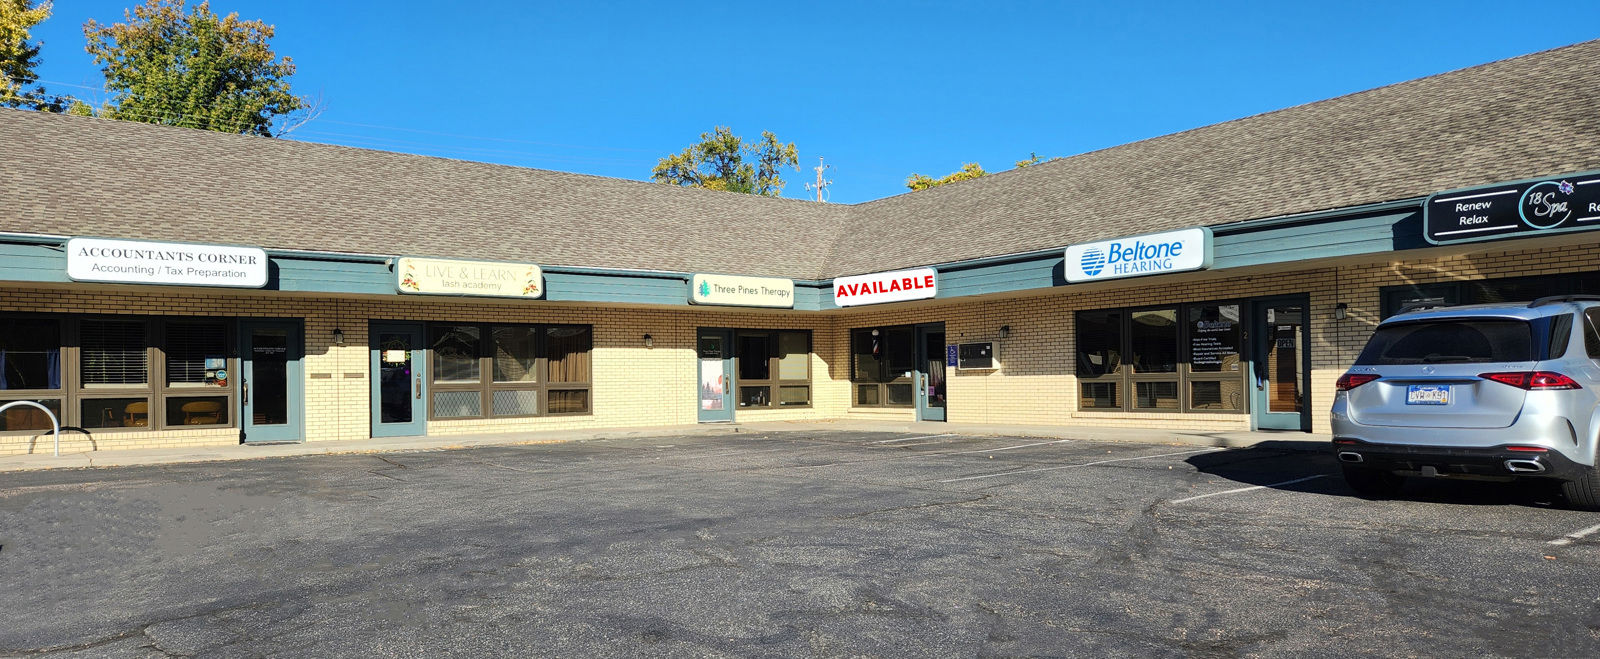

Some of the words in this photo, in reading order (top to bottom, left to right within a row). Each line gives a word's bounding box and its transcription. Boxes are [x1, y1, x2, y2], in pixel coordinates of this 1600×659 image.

[1529, 192, 1542, 205] 18
[1534, 192, 1568, 218] Spa
[1455, 201, 1492, 212] Renew
[1459, 215, 1489, 225] Relax
[78, 247, 194, 261] ACCOUNTANTS
[198, 253, 257, 265] CORNER
[1107, 241, 1183, 264] Beltone
[91, 263, 155, 276] Accounting
[165, 266, 183, 276] Tax
[187, 267, 247, 278] Preparation
[425, 264, 454, 279] LIVE
[459, 267, 469, 280] &
[473, 267, 516, 281] LEARN
[1114, 258, 1172, 274] HEARING
[442, 279, 460, 288] lash
[462, 280, 502, 291] academy
[714, 284, 735, 295] Three
[738, 285, 759, 295] Pines
[762, 285, 791, 298] Therapy
[836, 275, 934, 298] AVAILABLE
[1277, 339, 1293, 348] OPEN
